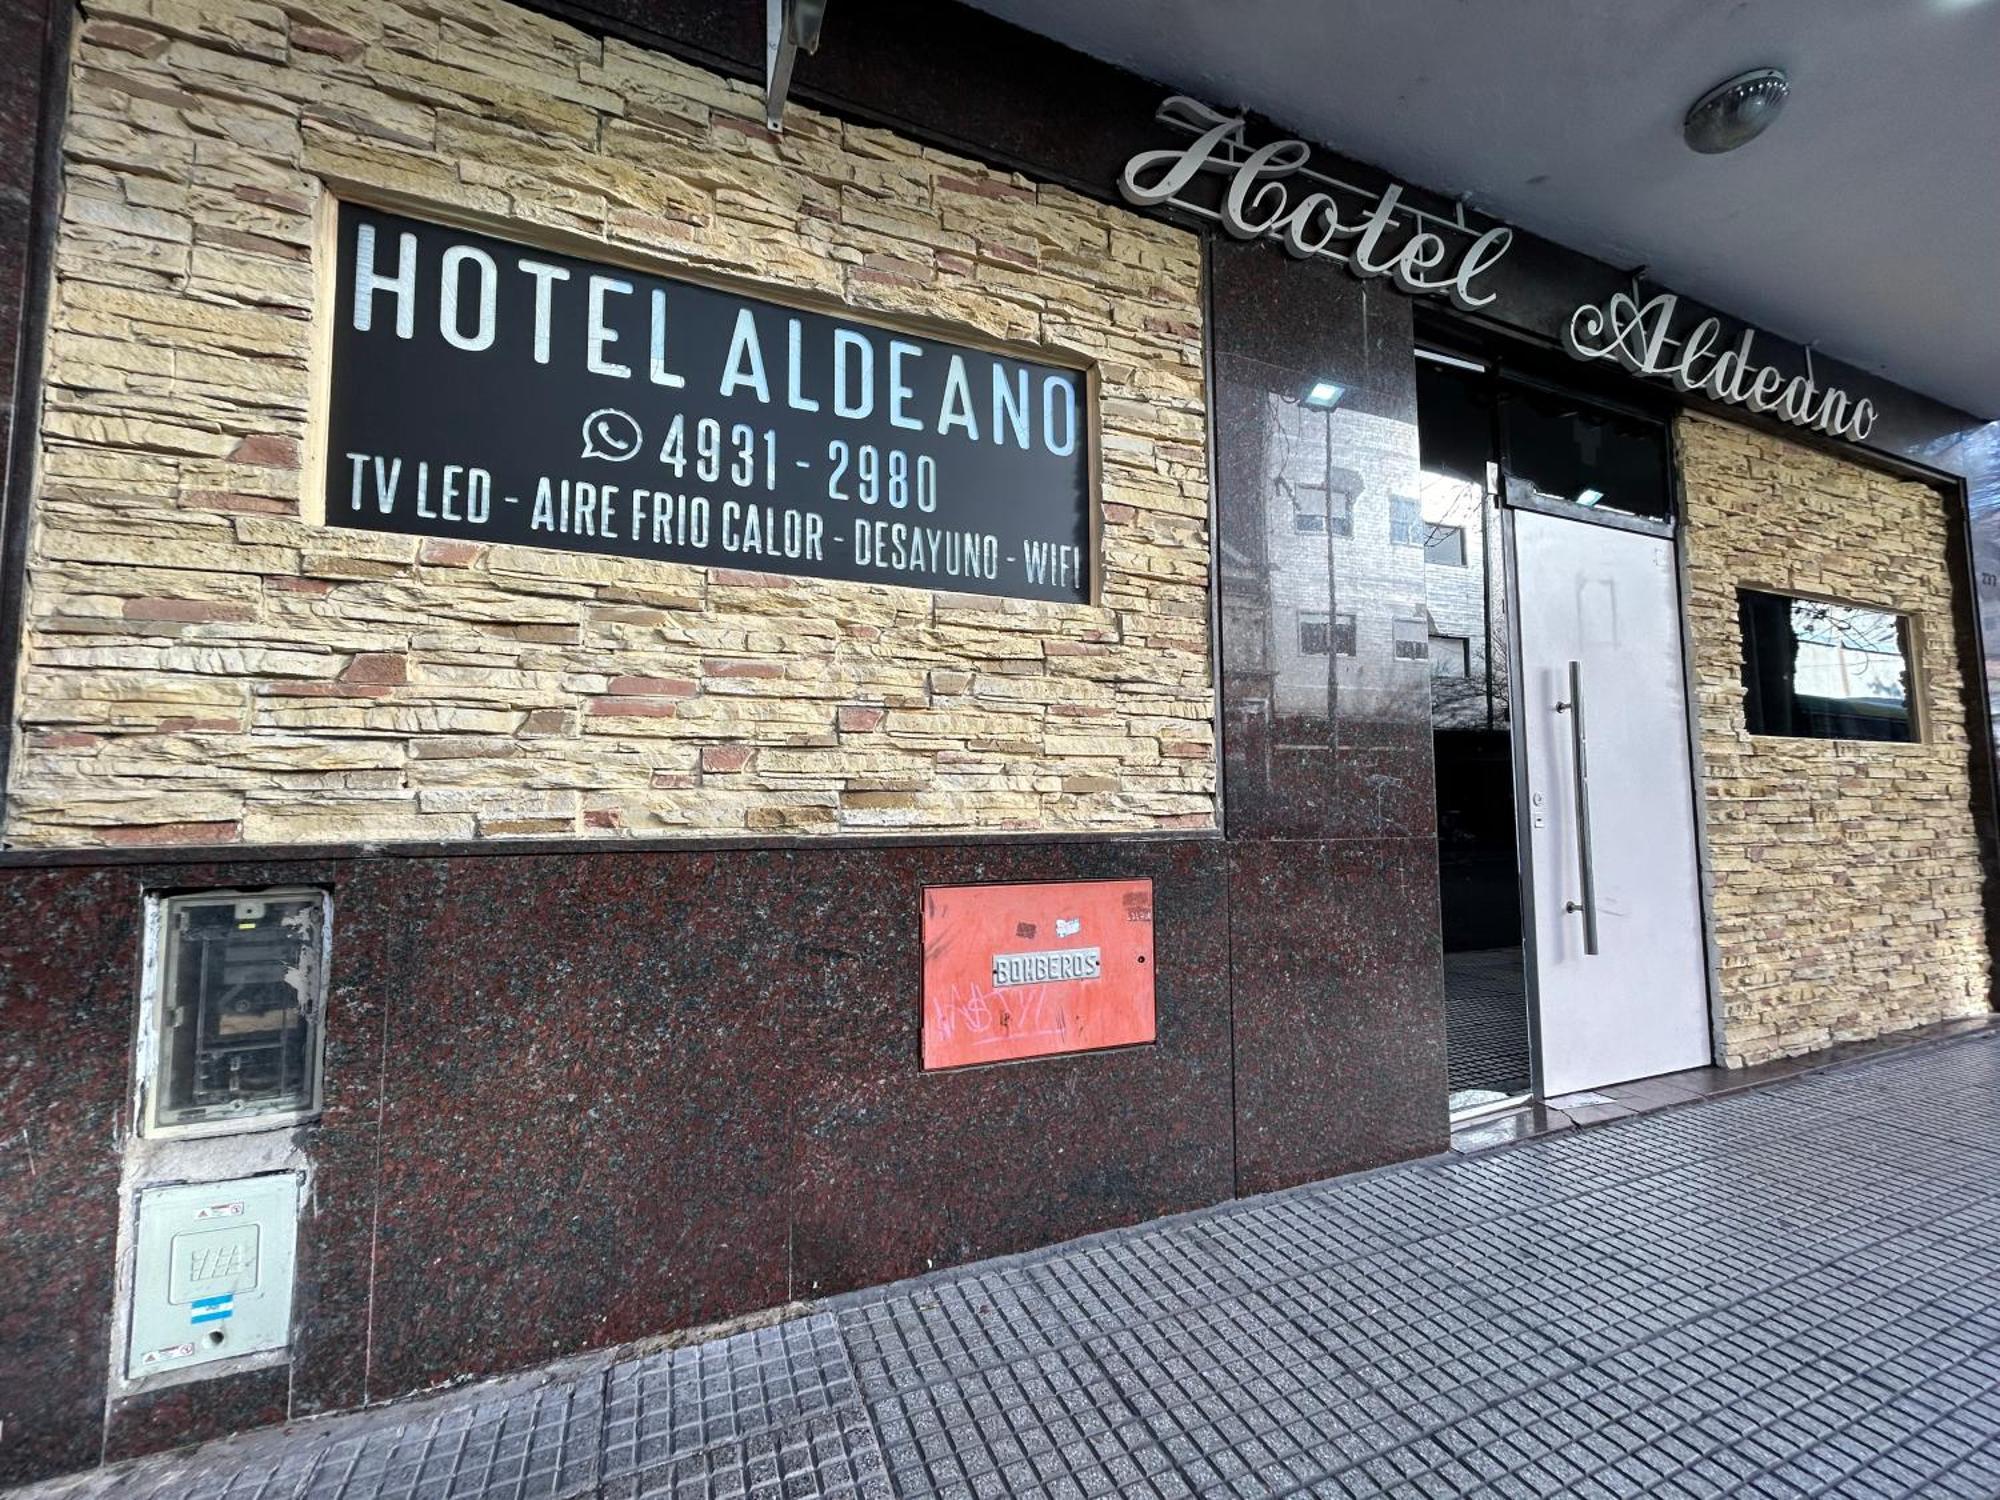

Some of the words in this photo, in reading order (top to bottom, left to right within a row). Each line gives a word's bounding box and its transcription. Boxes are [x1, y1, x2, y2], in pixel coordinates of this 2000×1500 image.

[1119, 96, 1513, 310] Hotel
[1564, 292, 1878, 441] Aldeano
[352, 223, 685, 389] HOTEL
[719, 307, 1076, 457] ALDEANO
[346, 452, 402, 514] TV
[416, 461, 492, 524] LED
[530, 476, 620, 539] AIRE
[631, 488, 710, 549] FRIO
[721, 500, 825, 561] CALOR
[854, 517, 999, 581] DESAYUNO
[1023, 539, 1080, 589] WIFI
[659, 412, 777, 491] 4931
[828, 439, 937, 513] 2980
[996, 955, 1097, 984] BOMBEROS
